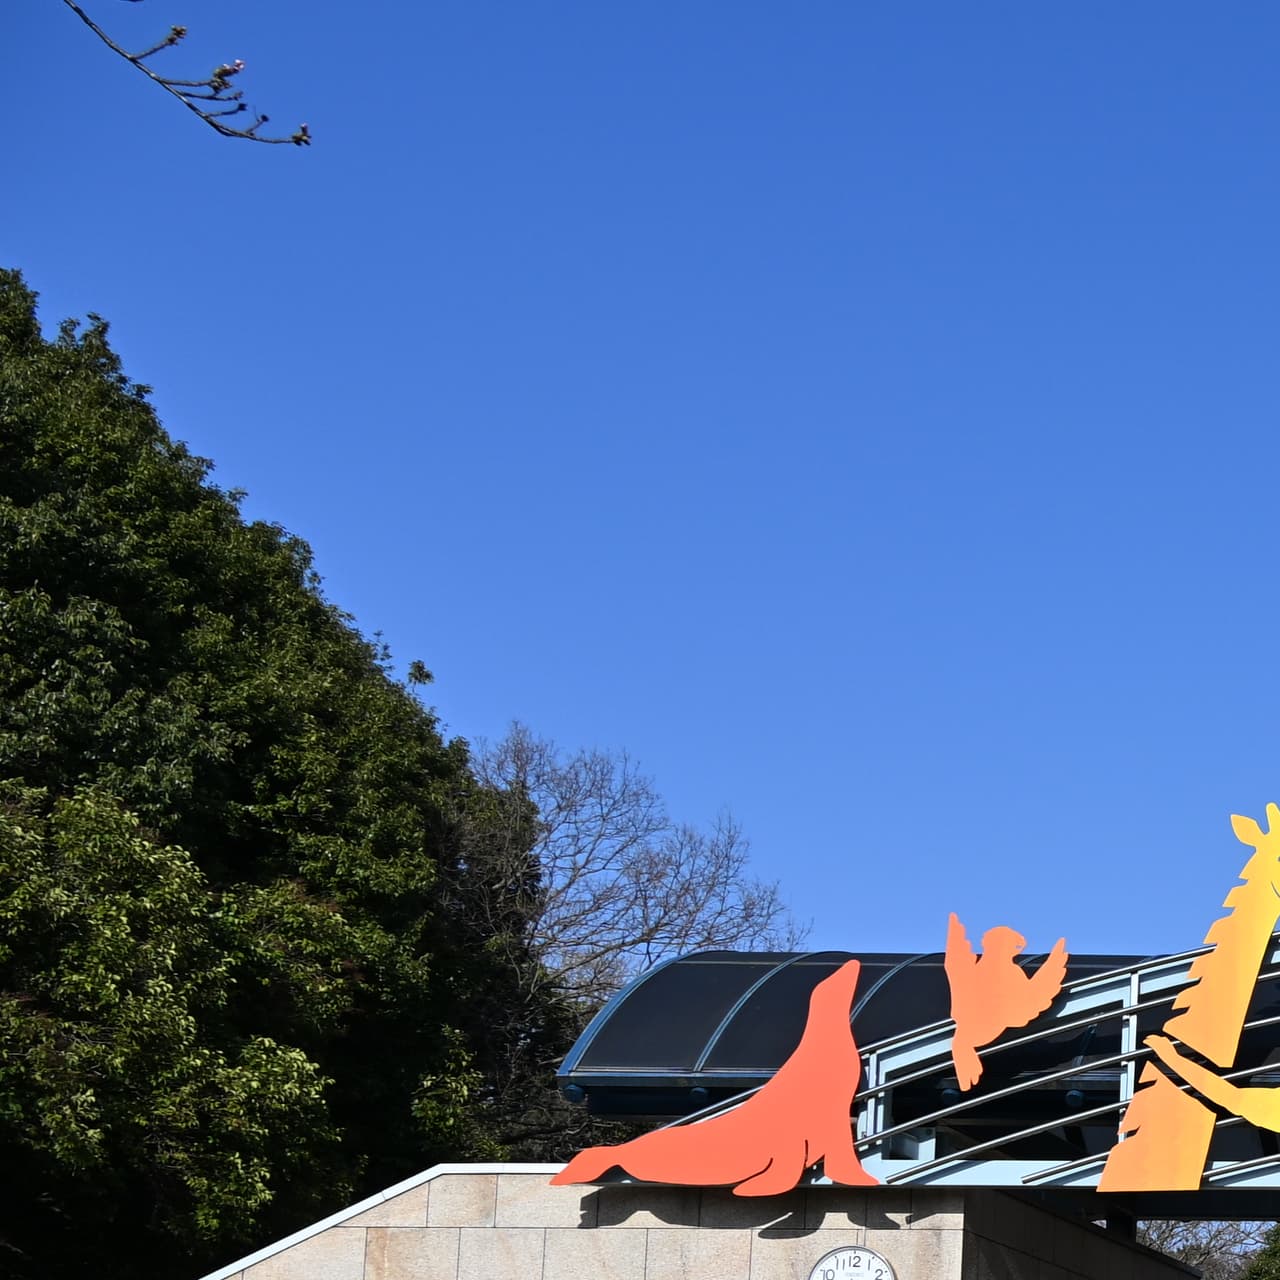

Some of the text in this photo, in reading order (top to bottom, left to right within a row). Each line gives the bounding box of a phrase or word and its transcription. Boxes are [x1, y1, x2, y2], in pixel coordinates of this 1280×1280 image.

[836, 1258, 846, 1271] 11
[849, 1255, 862, 1268] 12
[820, 1269, 835, 1280] 10
[874, 1269, 884, 1280] 2
